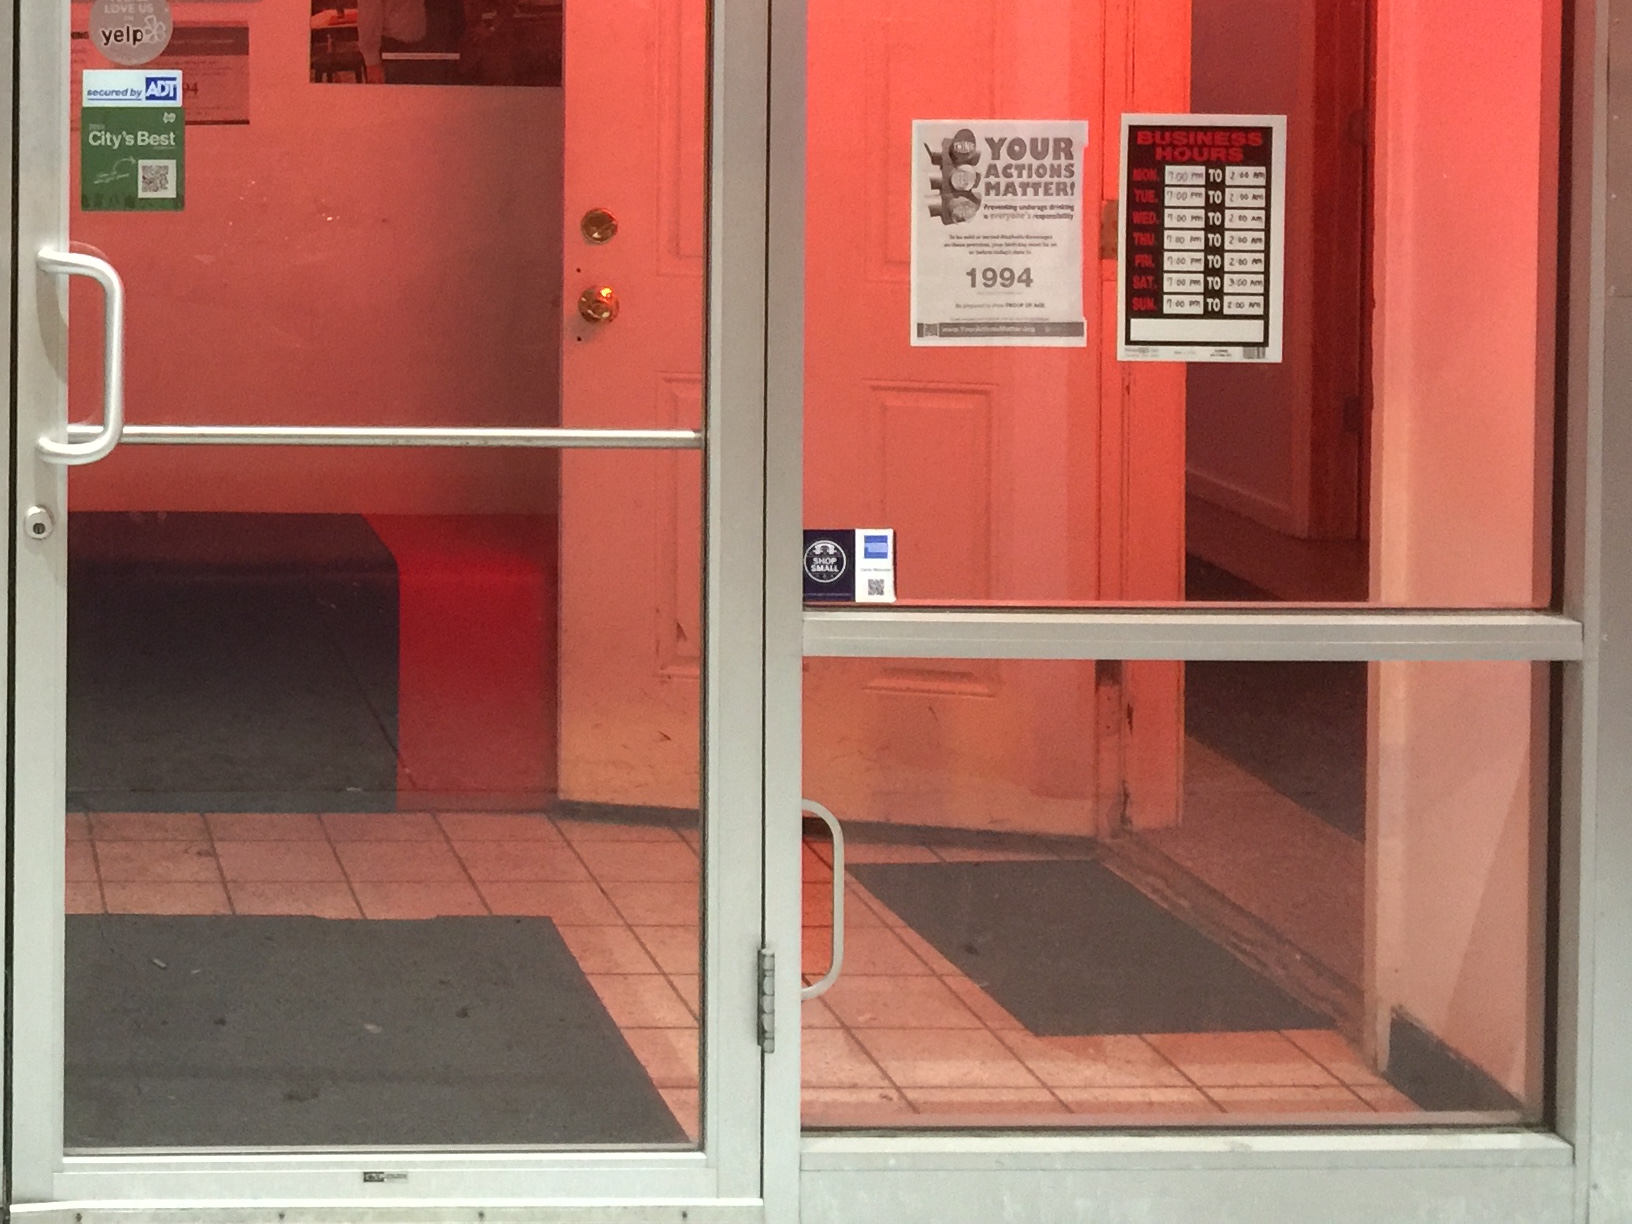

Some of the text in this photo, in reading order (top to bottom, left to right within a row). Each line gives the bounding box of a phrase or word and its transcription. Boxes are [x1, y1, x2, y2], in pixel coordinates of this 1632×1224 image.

[104, 4, 153, 14] LOVE US
[102, 26, 144, 46] yelp
[87, 79, 177, 98] secured by ADT
[89, 131, 176, 150] City's Best
[1137, 131, 1262, 146] BUSINESS
[984, 137, 1074, 161] YOUR
[1155, 146, 1243, 162] HOURS
[984, 163, 1075, 178] ACTIONS
[1208, 169, 1222, 182] TO
[984, 182, 1075, 197] MATTER!
[1208, 191, 1222, 204] TO
[984, 204, 1017, 212] Preventing
[1049, 204, 1074, 212] drinking
[1208, 212, 1222, 225] TO
[1208, 234, 1221, 247] TO
[1207, 255, 1221, 269] TO
[966, 267, 1034, 288] 1994
[1207, 277, 1221, 290] TO
[1207, 298, 1220, 312] TO
[811, 564, 839, 572] SMALL
